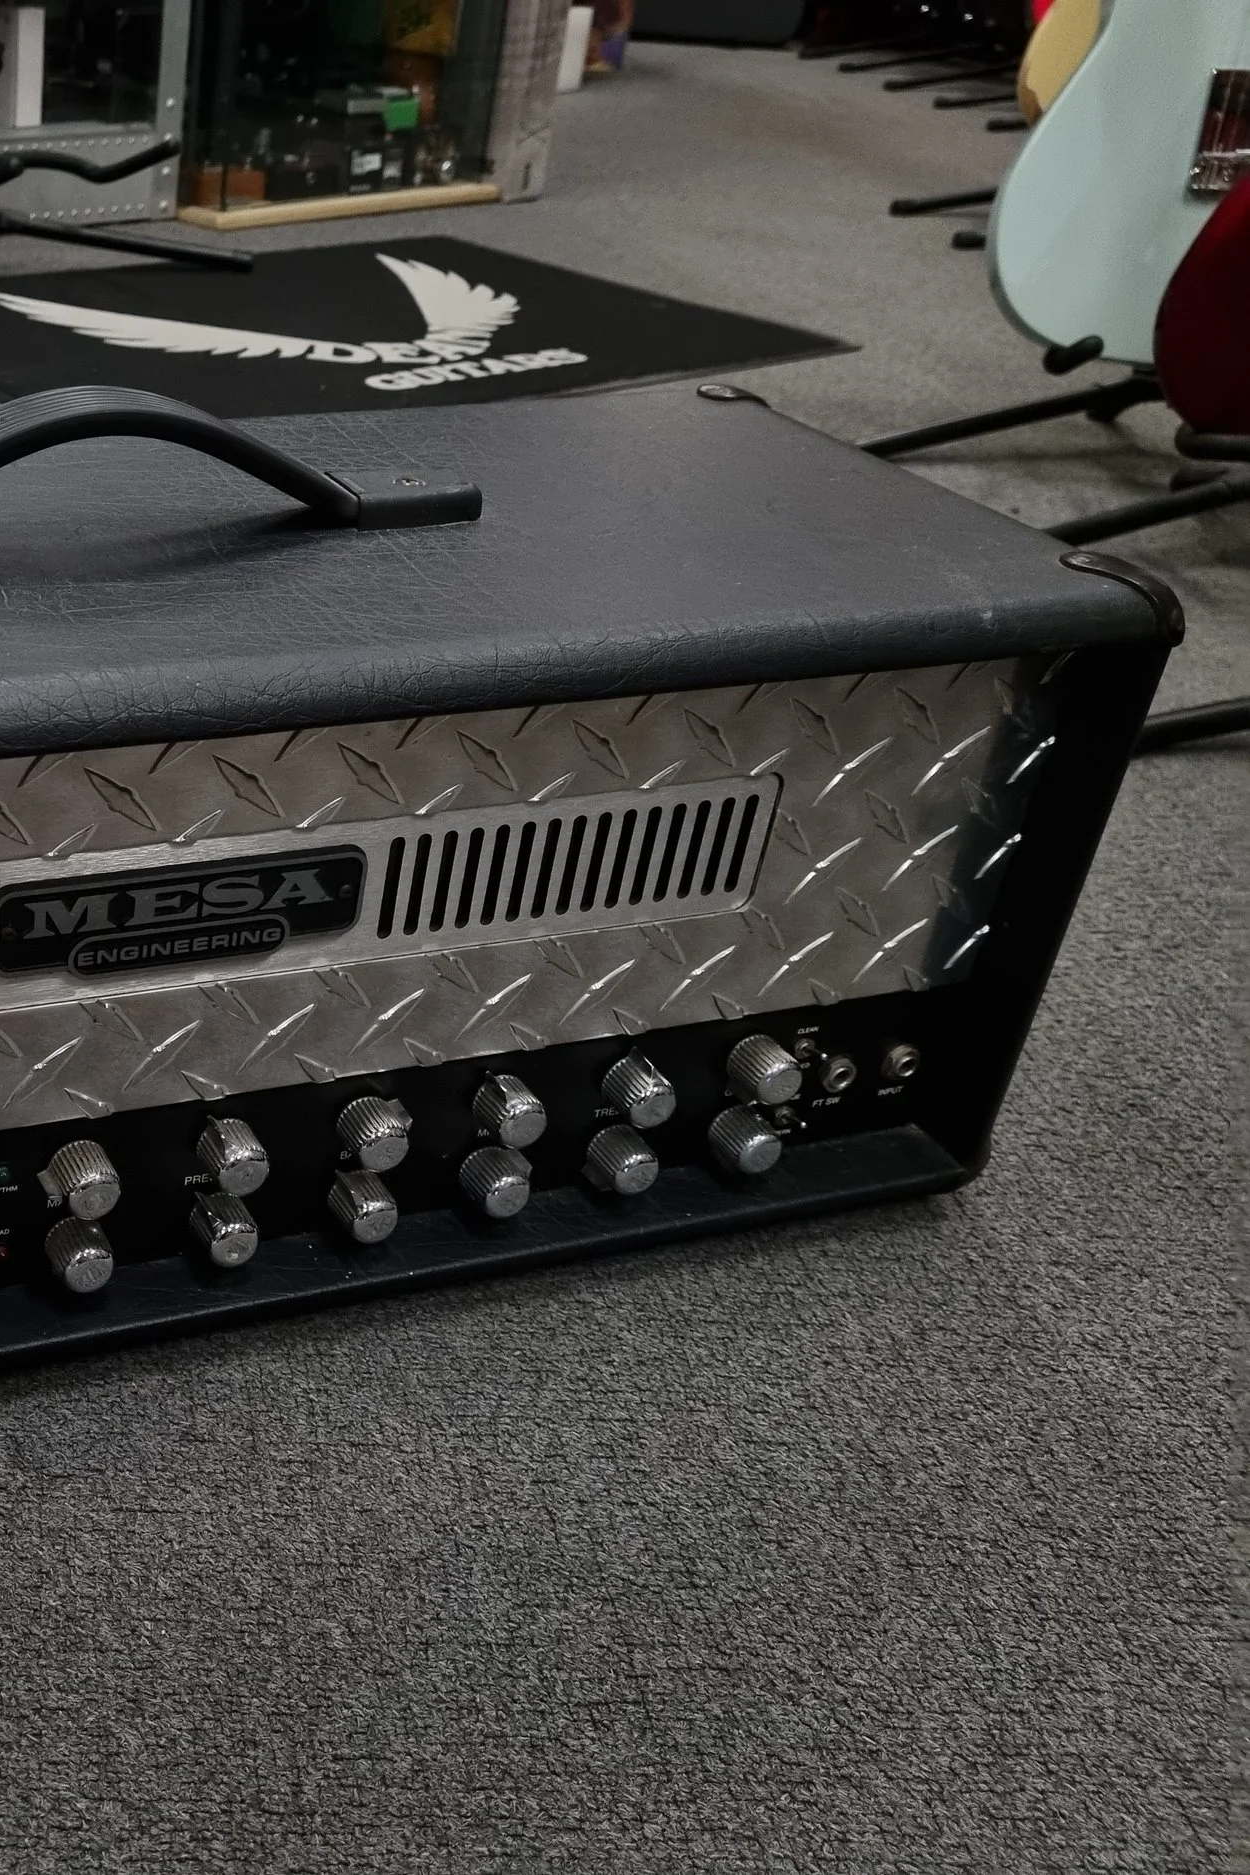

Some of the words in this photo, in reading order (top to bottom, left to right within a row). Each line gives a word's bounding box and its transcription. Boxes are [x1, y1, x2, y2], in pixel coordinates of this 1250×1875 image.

[364, 347, 589, 391] GUITARS
[23, 868, 336, 941] MESA
[77, 927, 282, 967] ENGINEERING
[797, 1026, 820, 1035] CLEAN
[811, 1098, 825, 1108] FT
[825, 1096, 842, 1106] SW
[877, 1085, 904, 1096] INPUT
